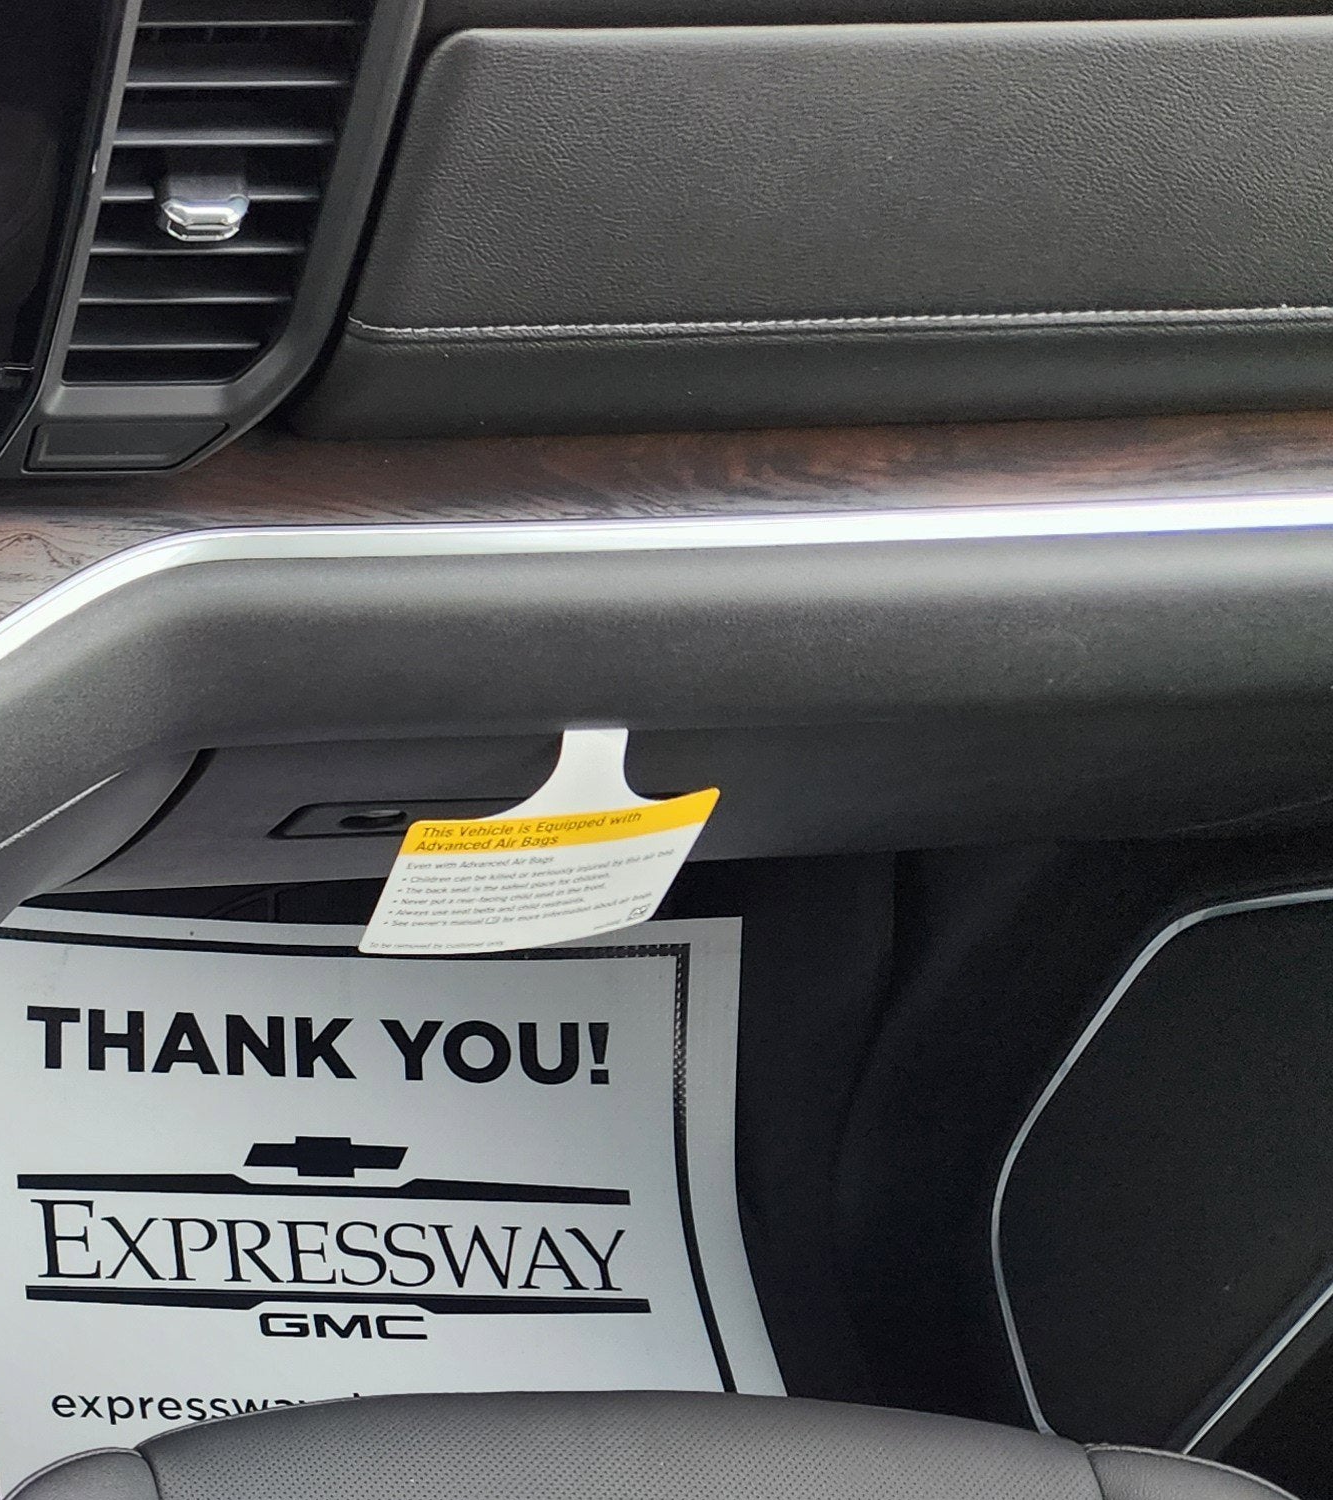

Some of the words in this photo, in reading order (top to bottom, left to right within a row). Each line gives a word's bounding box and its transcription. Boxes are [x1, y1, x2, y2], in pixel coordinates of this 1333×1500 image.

[423, 826, 454, 838] This
[459, 823, 513, 838] Vehicle
[518, 822, 531, 834] is
[535, 816, 607, 834] Equipped
[610, 811, 643, 825] with
[414, 838, 493, 852] Advanced
[495, 837, 519, 850] Air
[521, 835, 560, 851] Bags
[27, 1005, 358, 1081] THANK
[381, 1017, 611, 1087] YOU!
[31, 1198, 626, 1292] EXPRESSWAY
[259, 1312, 429, 1341] GMC
